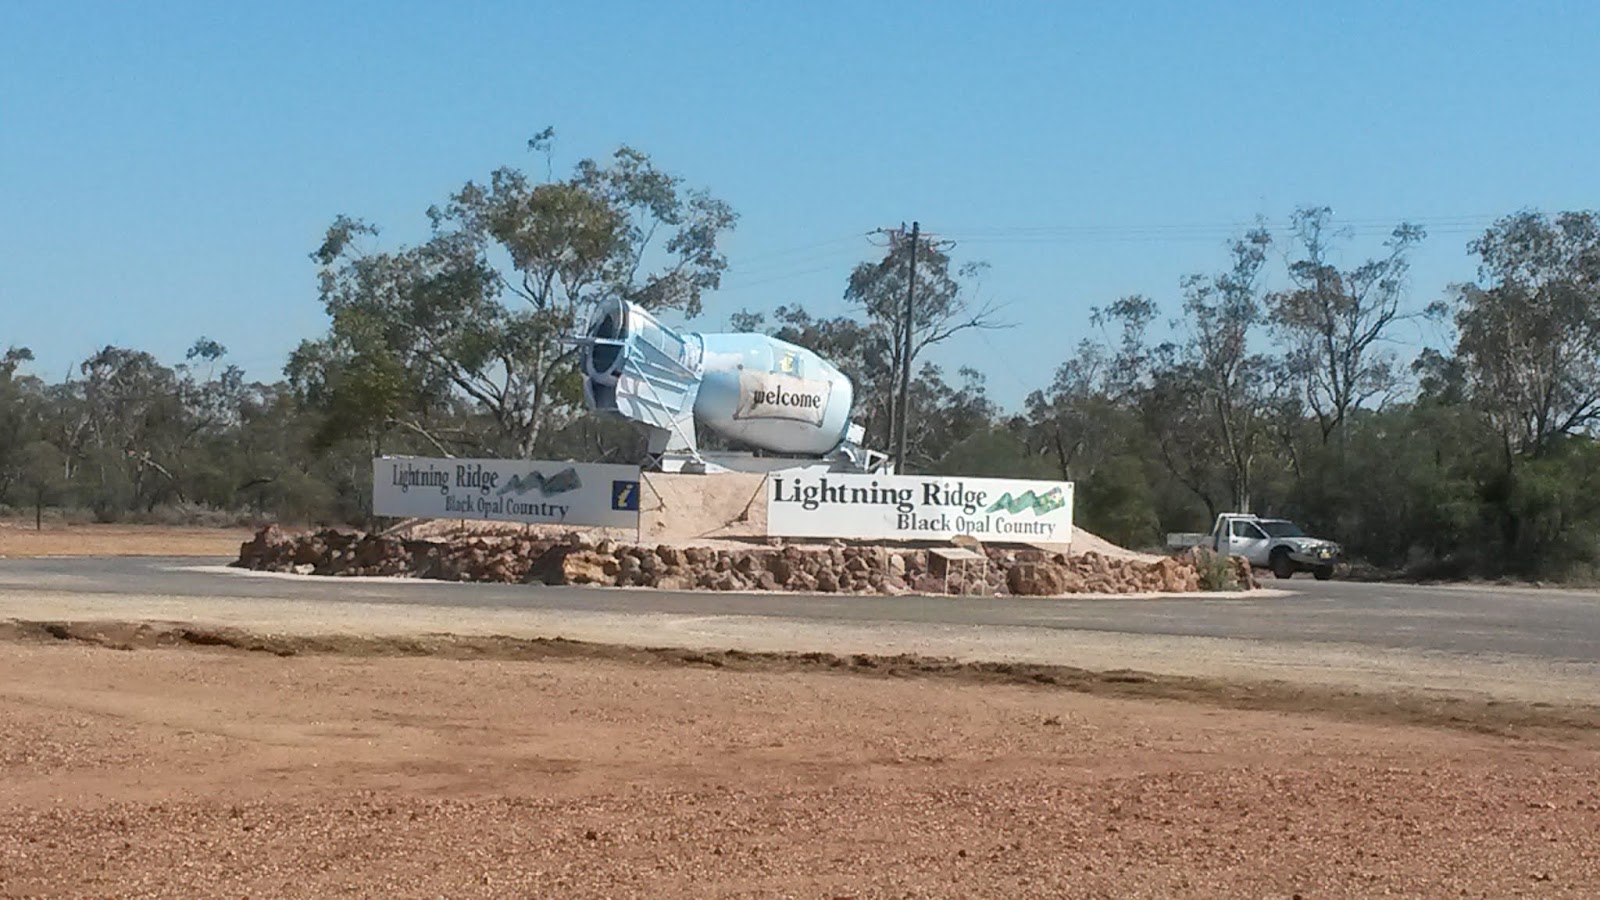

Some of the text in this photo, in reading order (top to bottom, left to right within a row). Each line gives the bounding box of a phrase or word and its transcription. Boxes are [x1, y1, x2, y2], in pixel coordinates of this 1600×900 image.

[753, 385, 821, 409] welcome
[392, 464, 499, 495] Lightning Ridge
[445, 497, 569, 521] Black Opal Country
[773, 478, 987, 514] Lightning Ridge
[896, 513, 1056, 539] Black Opal Country
